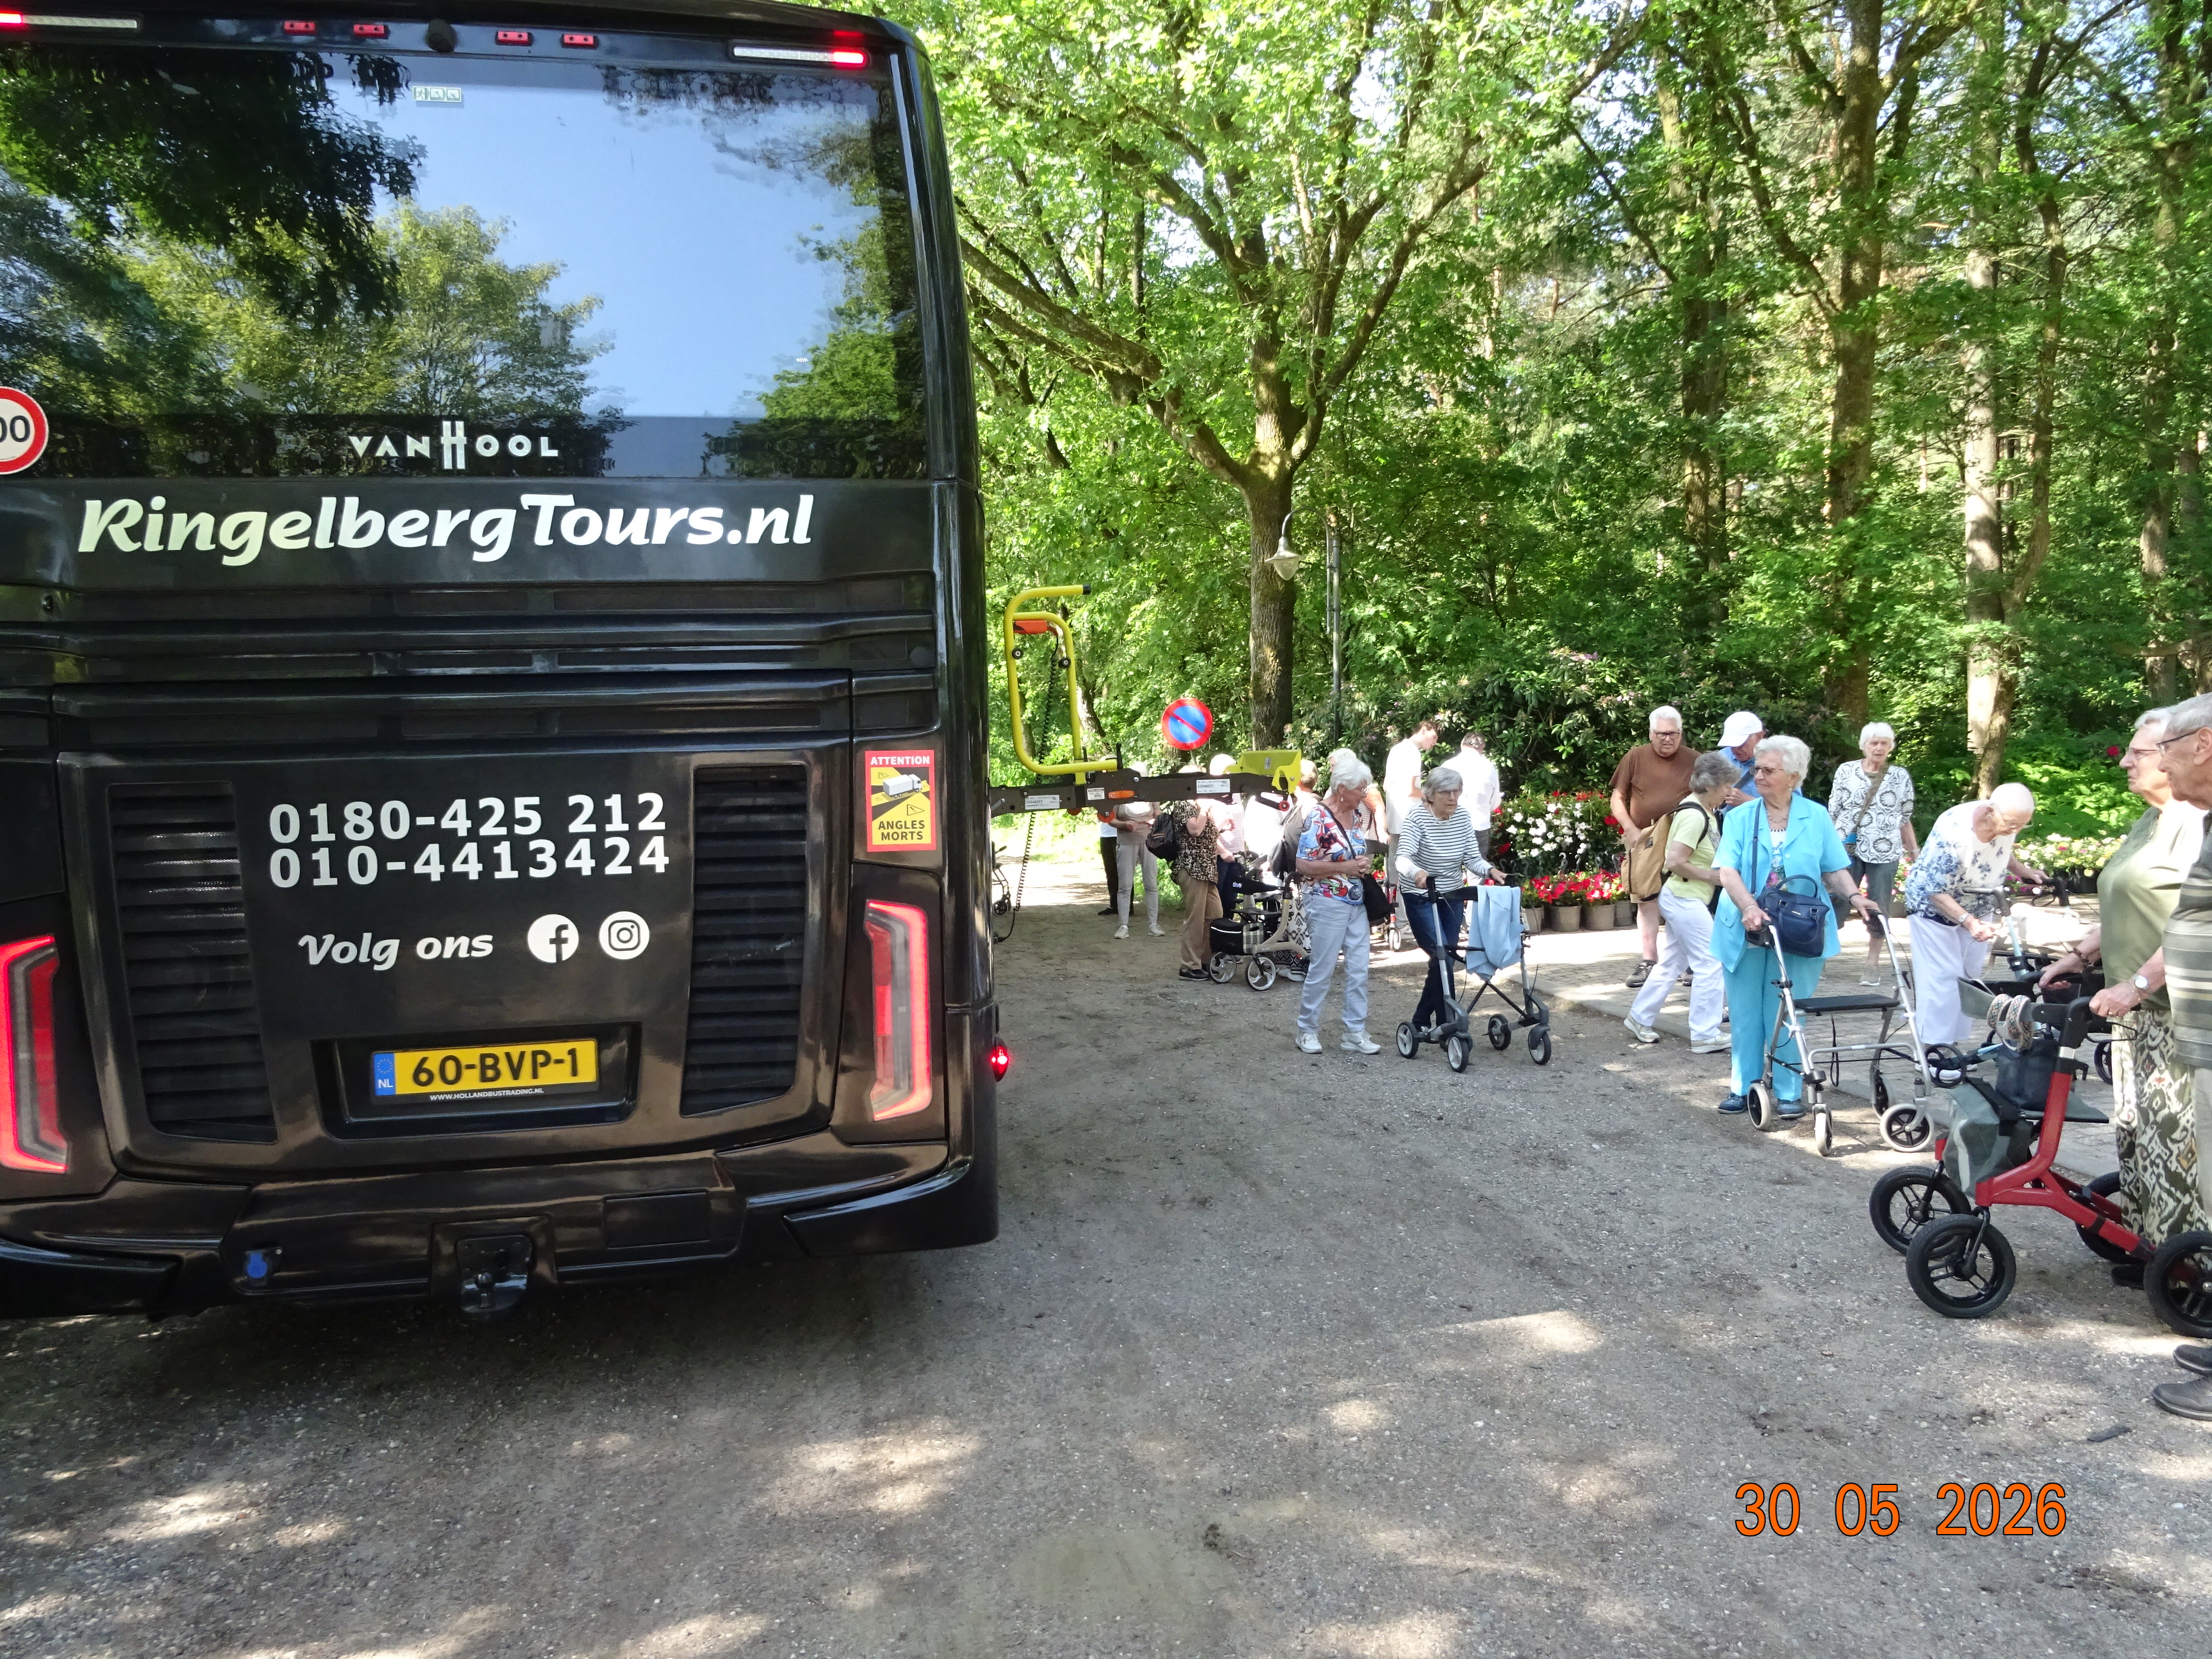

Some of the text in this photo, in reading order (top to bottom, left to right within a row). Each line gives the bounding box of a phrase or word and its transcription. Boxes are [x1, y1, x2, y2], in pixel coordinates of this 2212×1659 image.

[78, 494, 814, 566] RingelbergTours.nl
[870, 756, 930, 765] ATTENTION
[269, 793, 666, 843] 0180-425 212
[878, 820, 925, 830] ANGLES
[881, 831, 923, 841] MORTS
[269, 836, 669, 888] 010-4413424
[298, 932, 494, 971] Volg ons
[412, 1047, 578, 1087] 60-BVP-1
[378, 1078, 394, 1088] NL
[429, 1087, 544, 1101] WWW.HOLLANDBUSTRADING.NL
